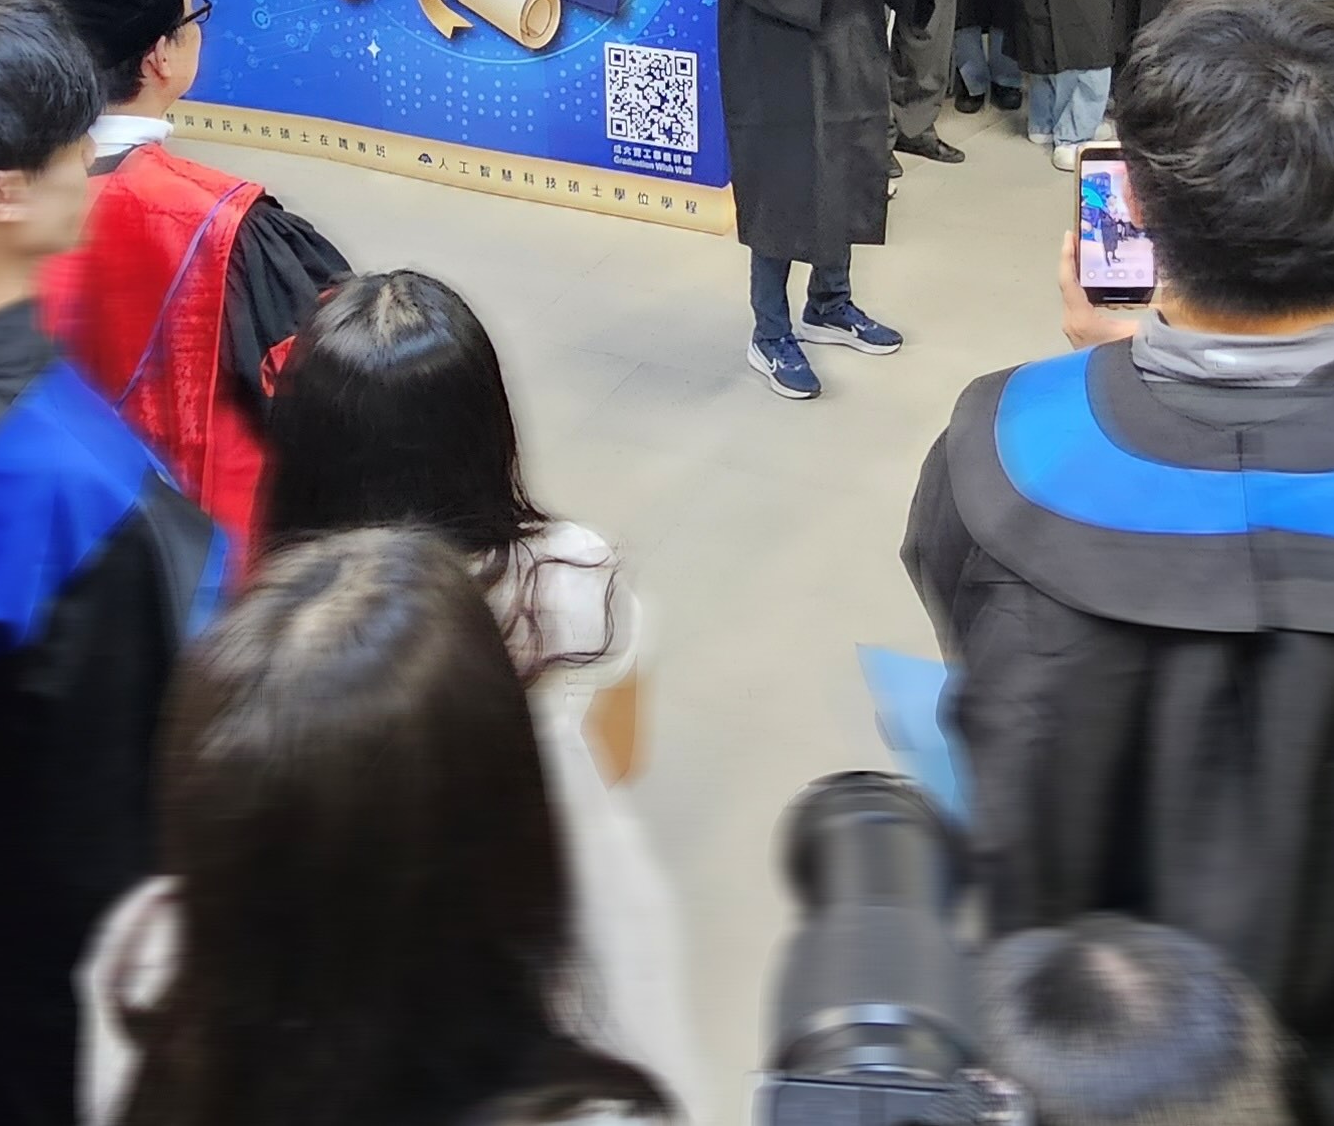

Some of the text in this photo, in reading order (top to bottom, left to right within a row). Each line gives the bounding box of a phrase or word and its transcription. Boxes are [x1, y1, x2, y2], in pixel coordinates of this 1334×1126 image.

[438, 157, 698, 215] 人工智慧科技碩士學位學程
